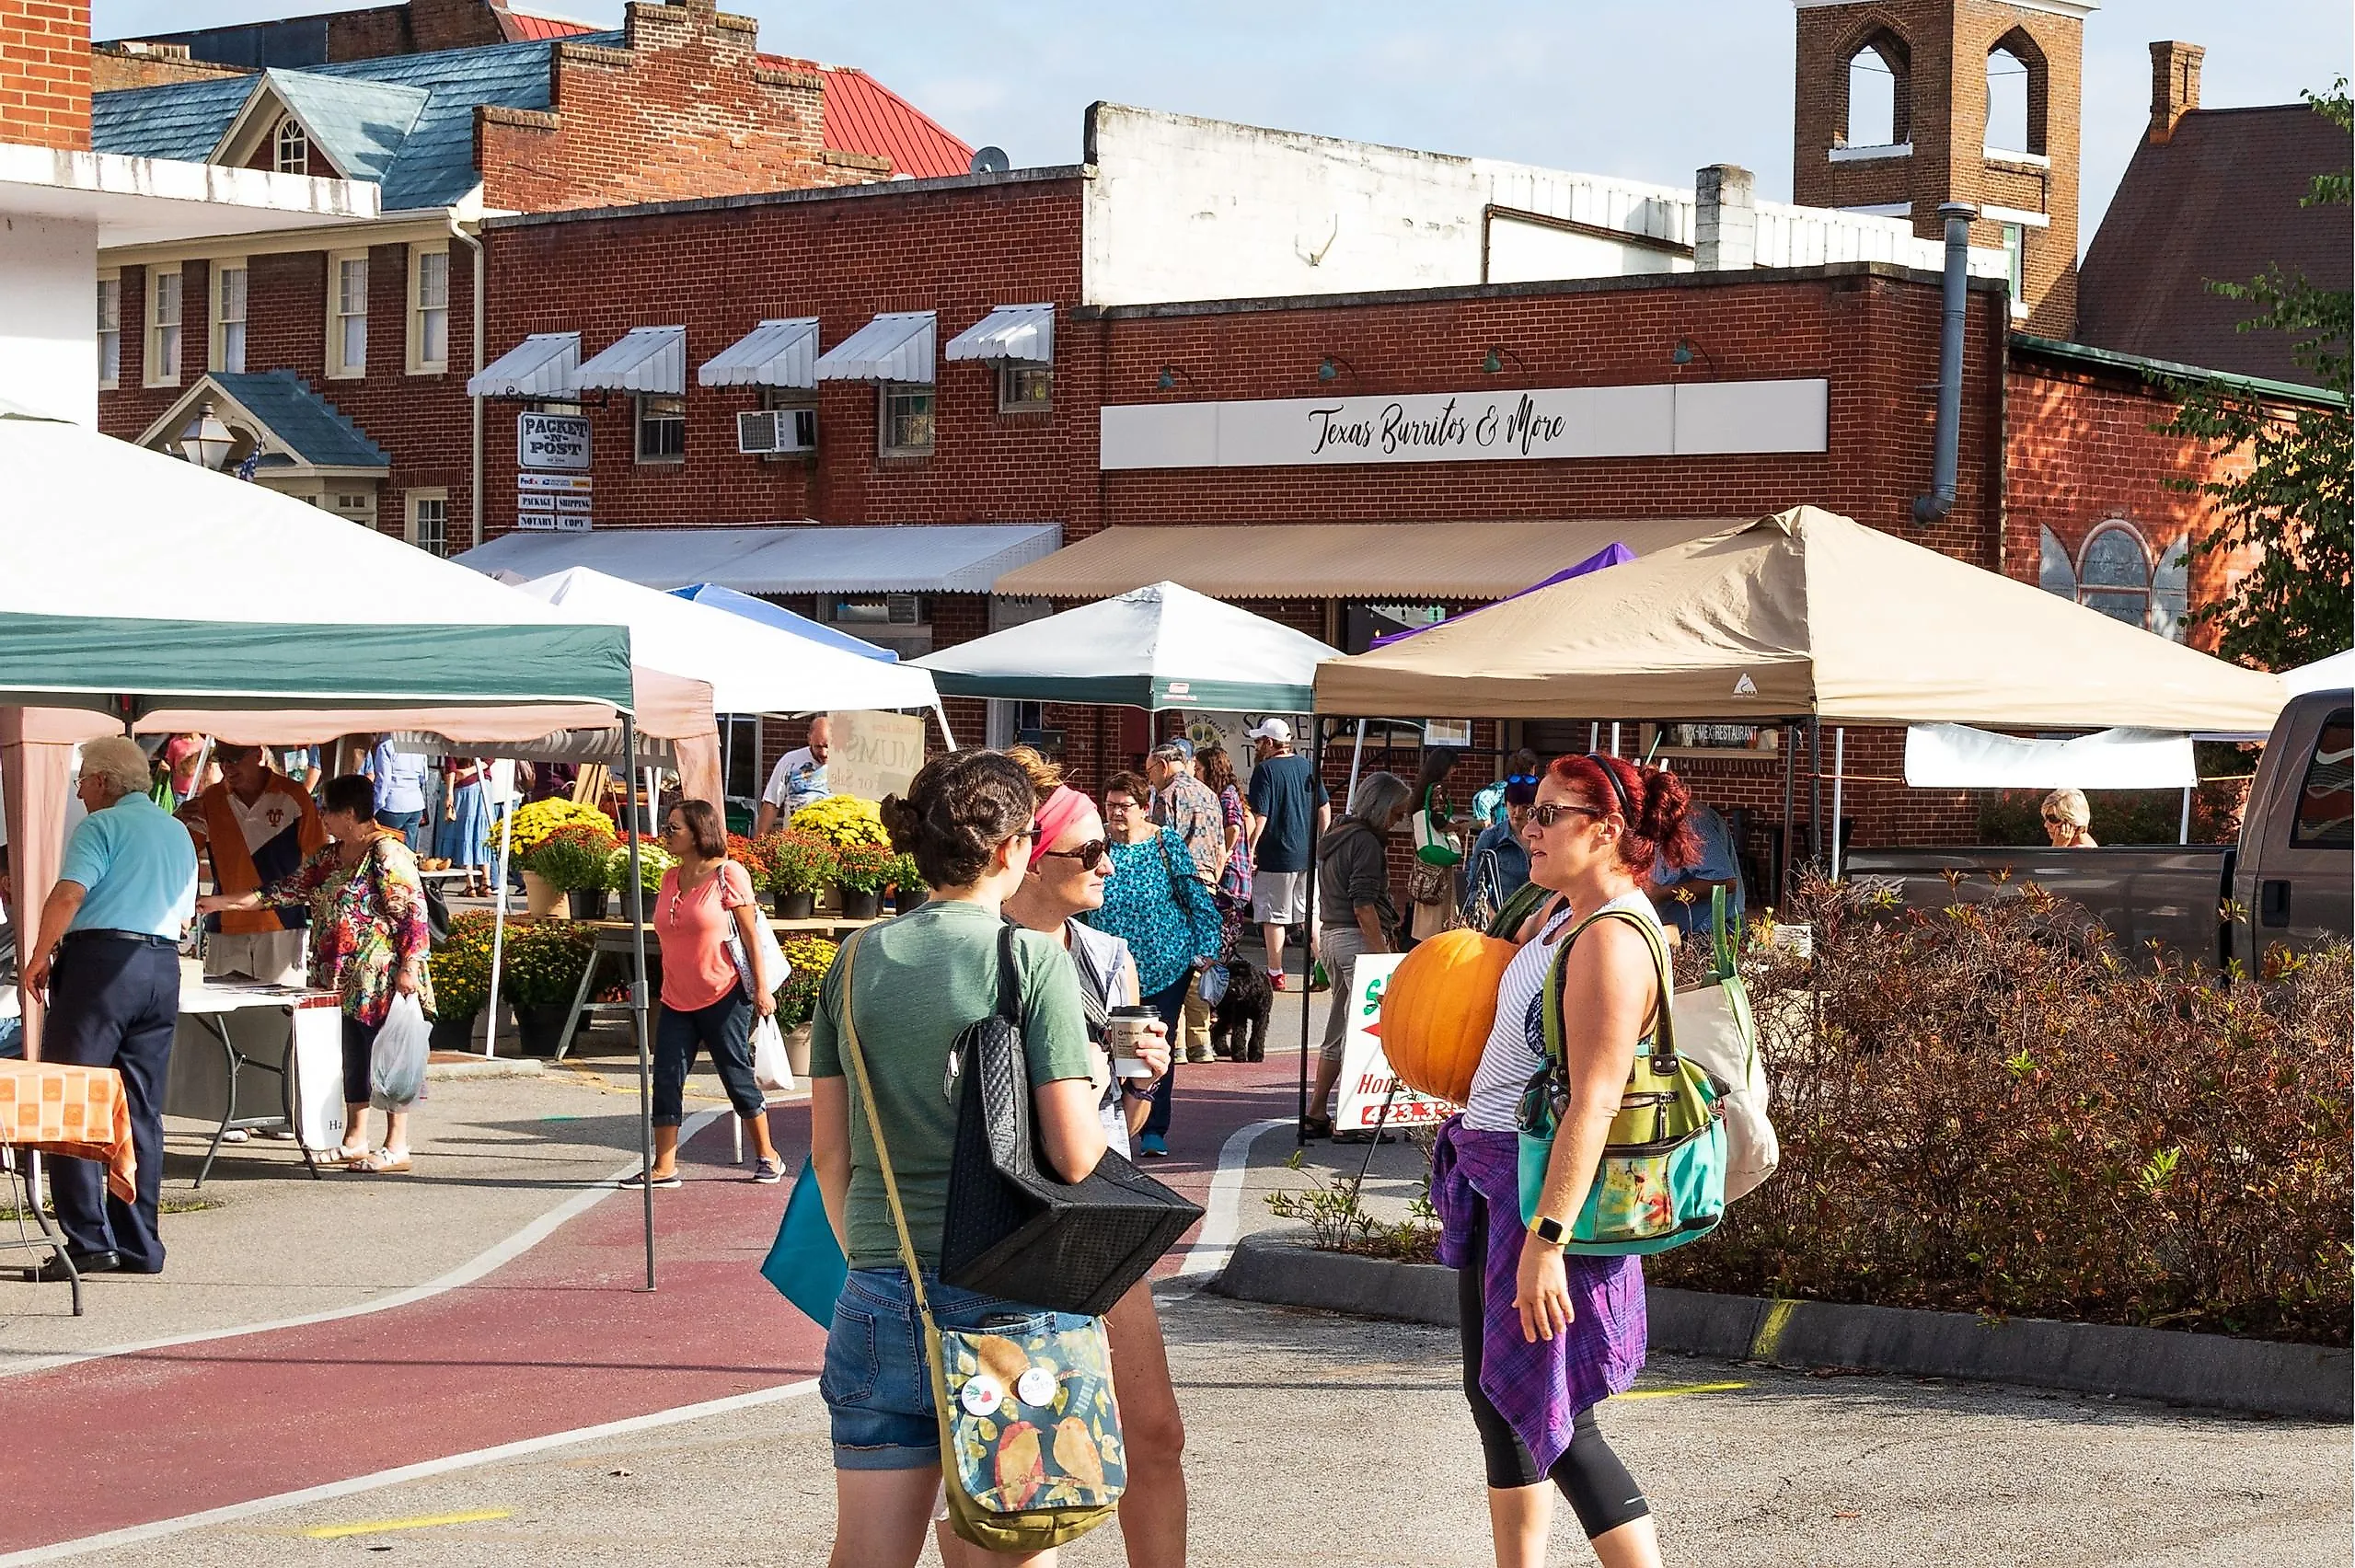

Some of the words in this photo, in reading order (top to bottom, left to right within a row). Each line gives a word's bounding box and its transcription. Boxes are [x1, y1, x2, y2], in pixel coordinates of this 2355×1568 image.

[525, 419, 588, 438] PACKET
[1309, 405, 1373, 455] Texas
[1380, 398, 1469, 455] Burritos
[1476, 405, 1499, 447] &
[1507, 394, 1567, 456] More
[529, 442, 582, 455] POST
[523, 498, 550, 507] PACKAGE
[559, 499, 589, 508] SHIPPING
[521, 517, 552, 526] NOTARY
[564, 518, 584, 527] COPY
[1714, 725, 1759, 742] RESTAURANT
